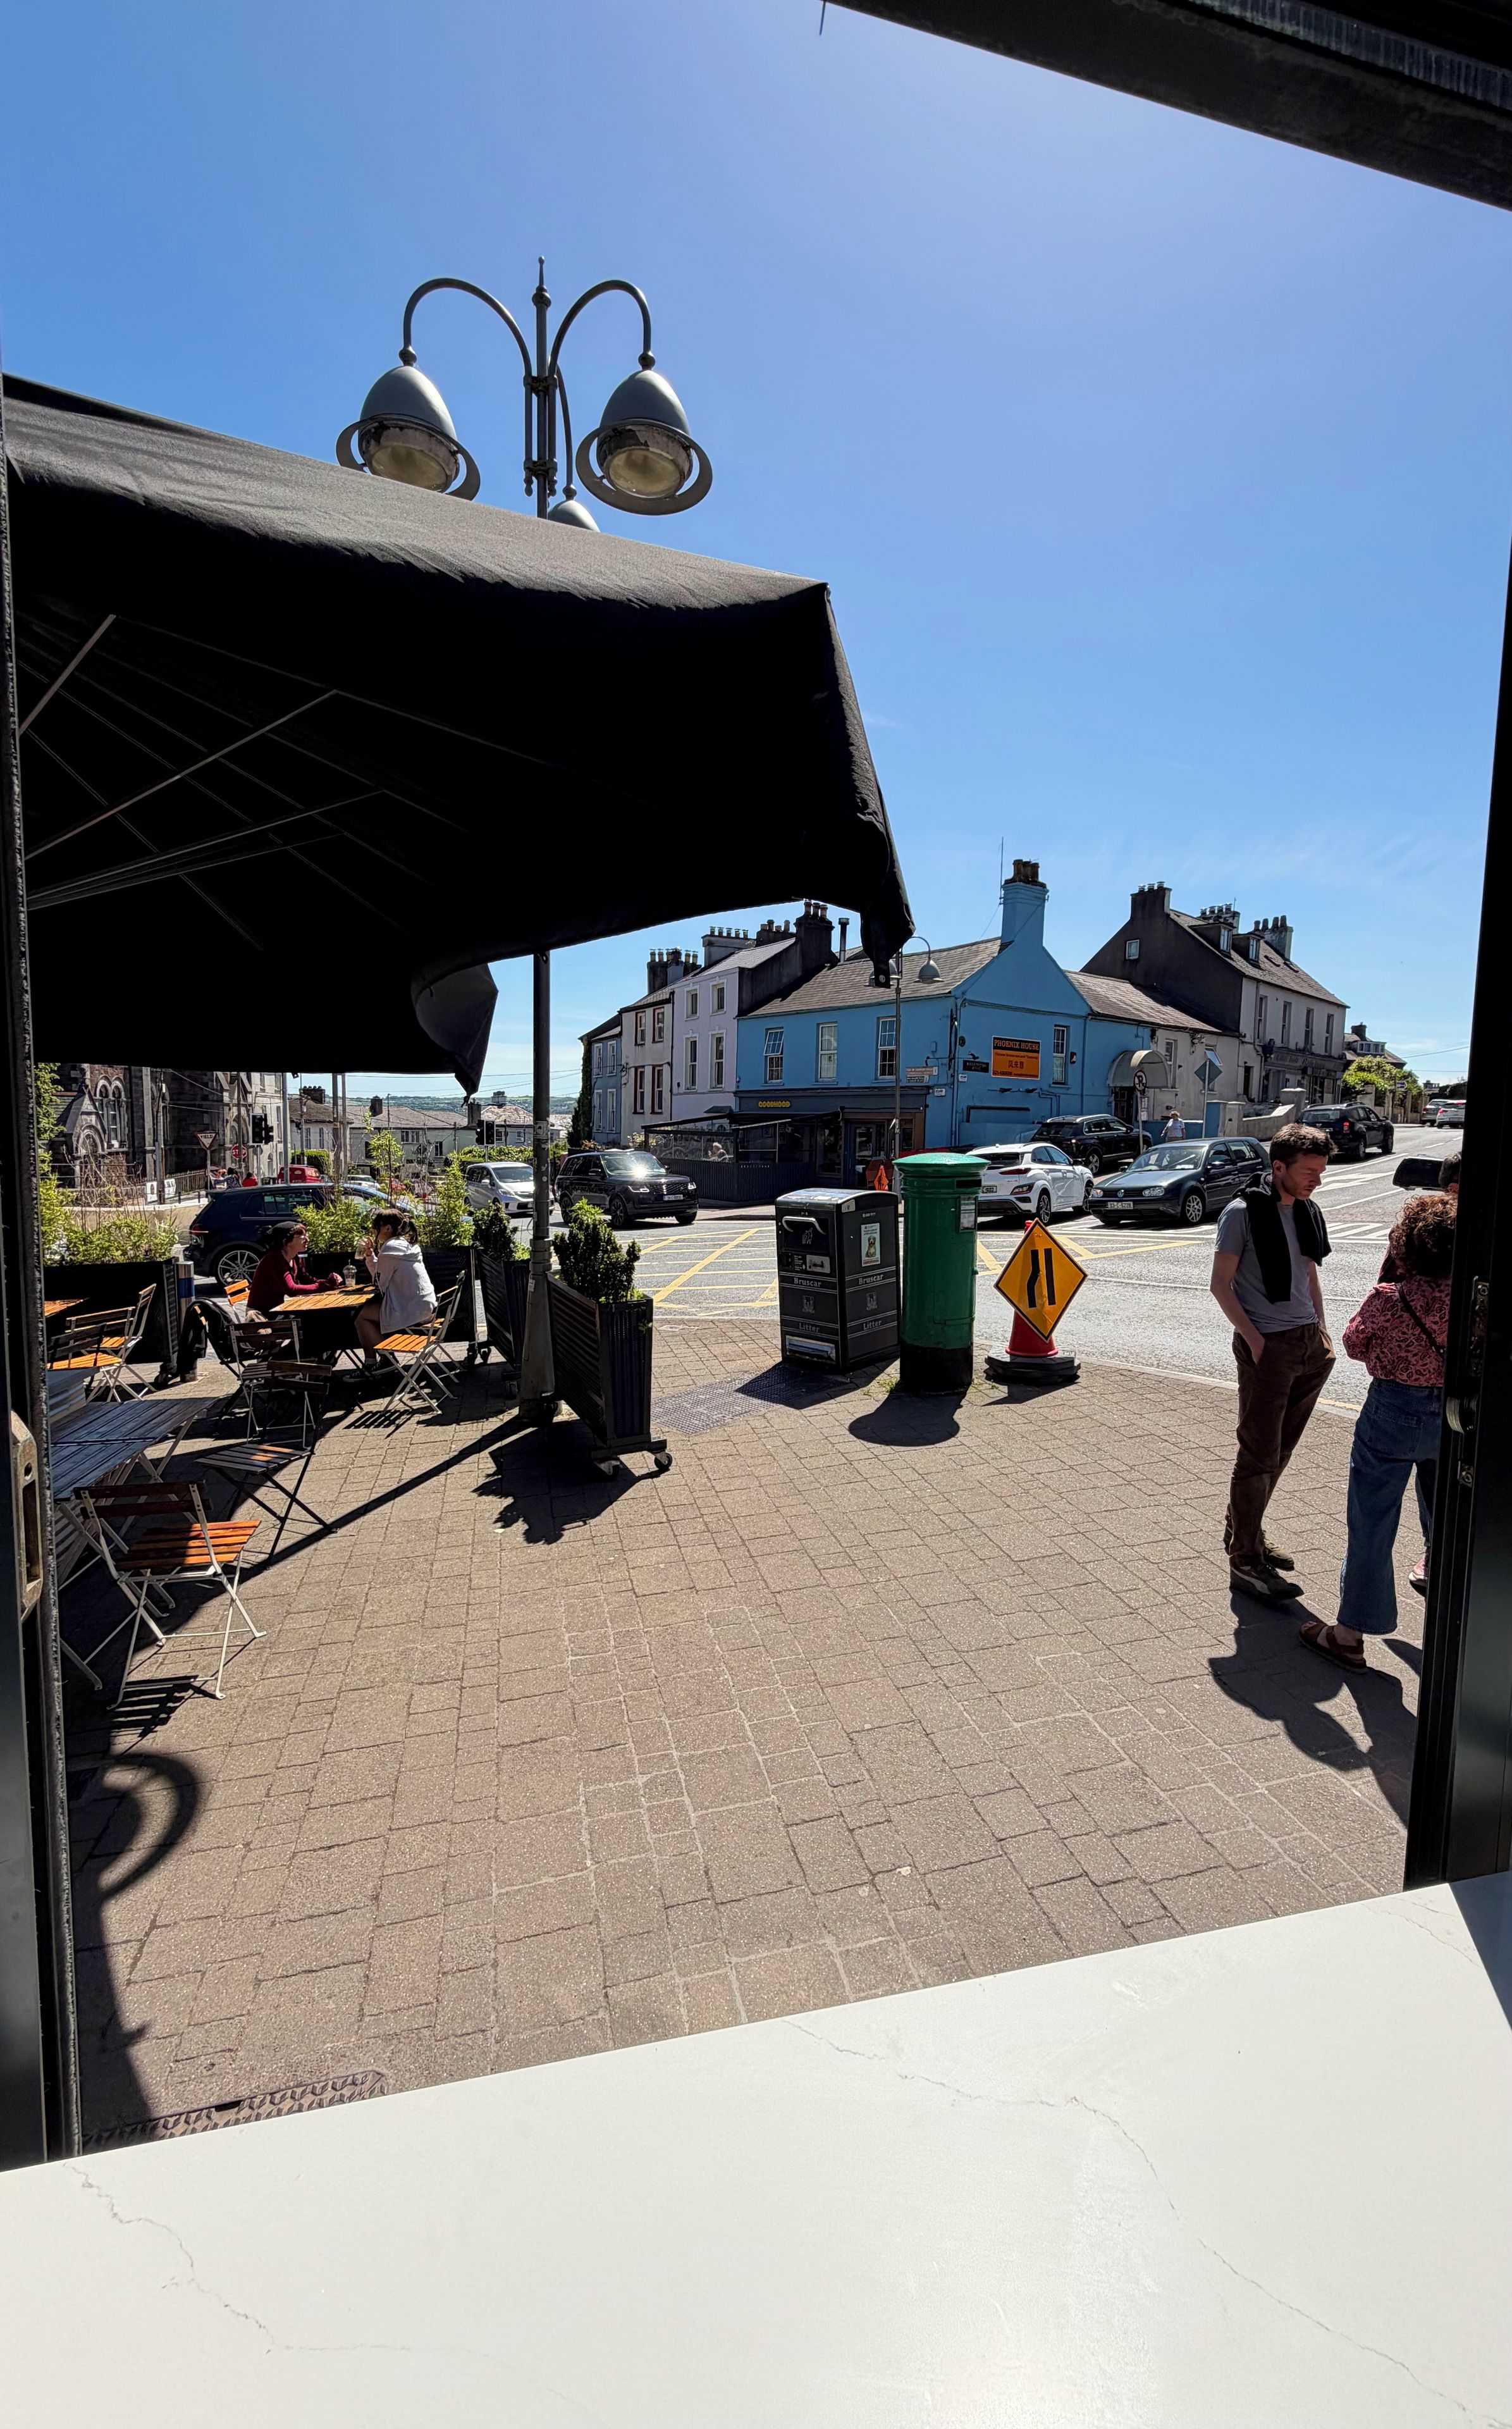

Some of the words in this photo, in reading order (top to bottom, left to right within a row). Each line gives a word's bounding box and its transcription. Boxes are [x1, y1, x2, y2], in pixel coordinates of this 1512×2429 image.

[994, 1039, 1020, 1049] PHOENIX
[1021, 1042, 1039, 1050] HOUSE
[794, 1277, 821, 1288] Bruscar
[859, 1274, 884, 1285] Bruscar
[799, 1322, 820, 1333] Litter
[863, 1320, 882, 1330] Litter
